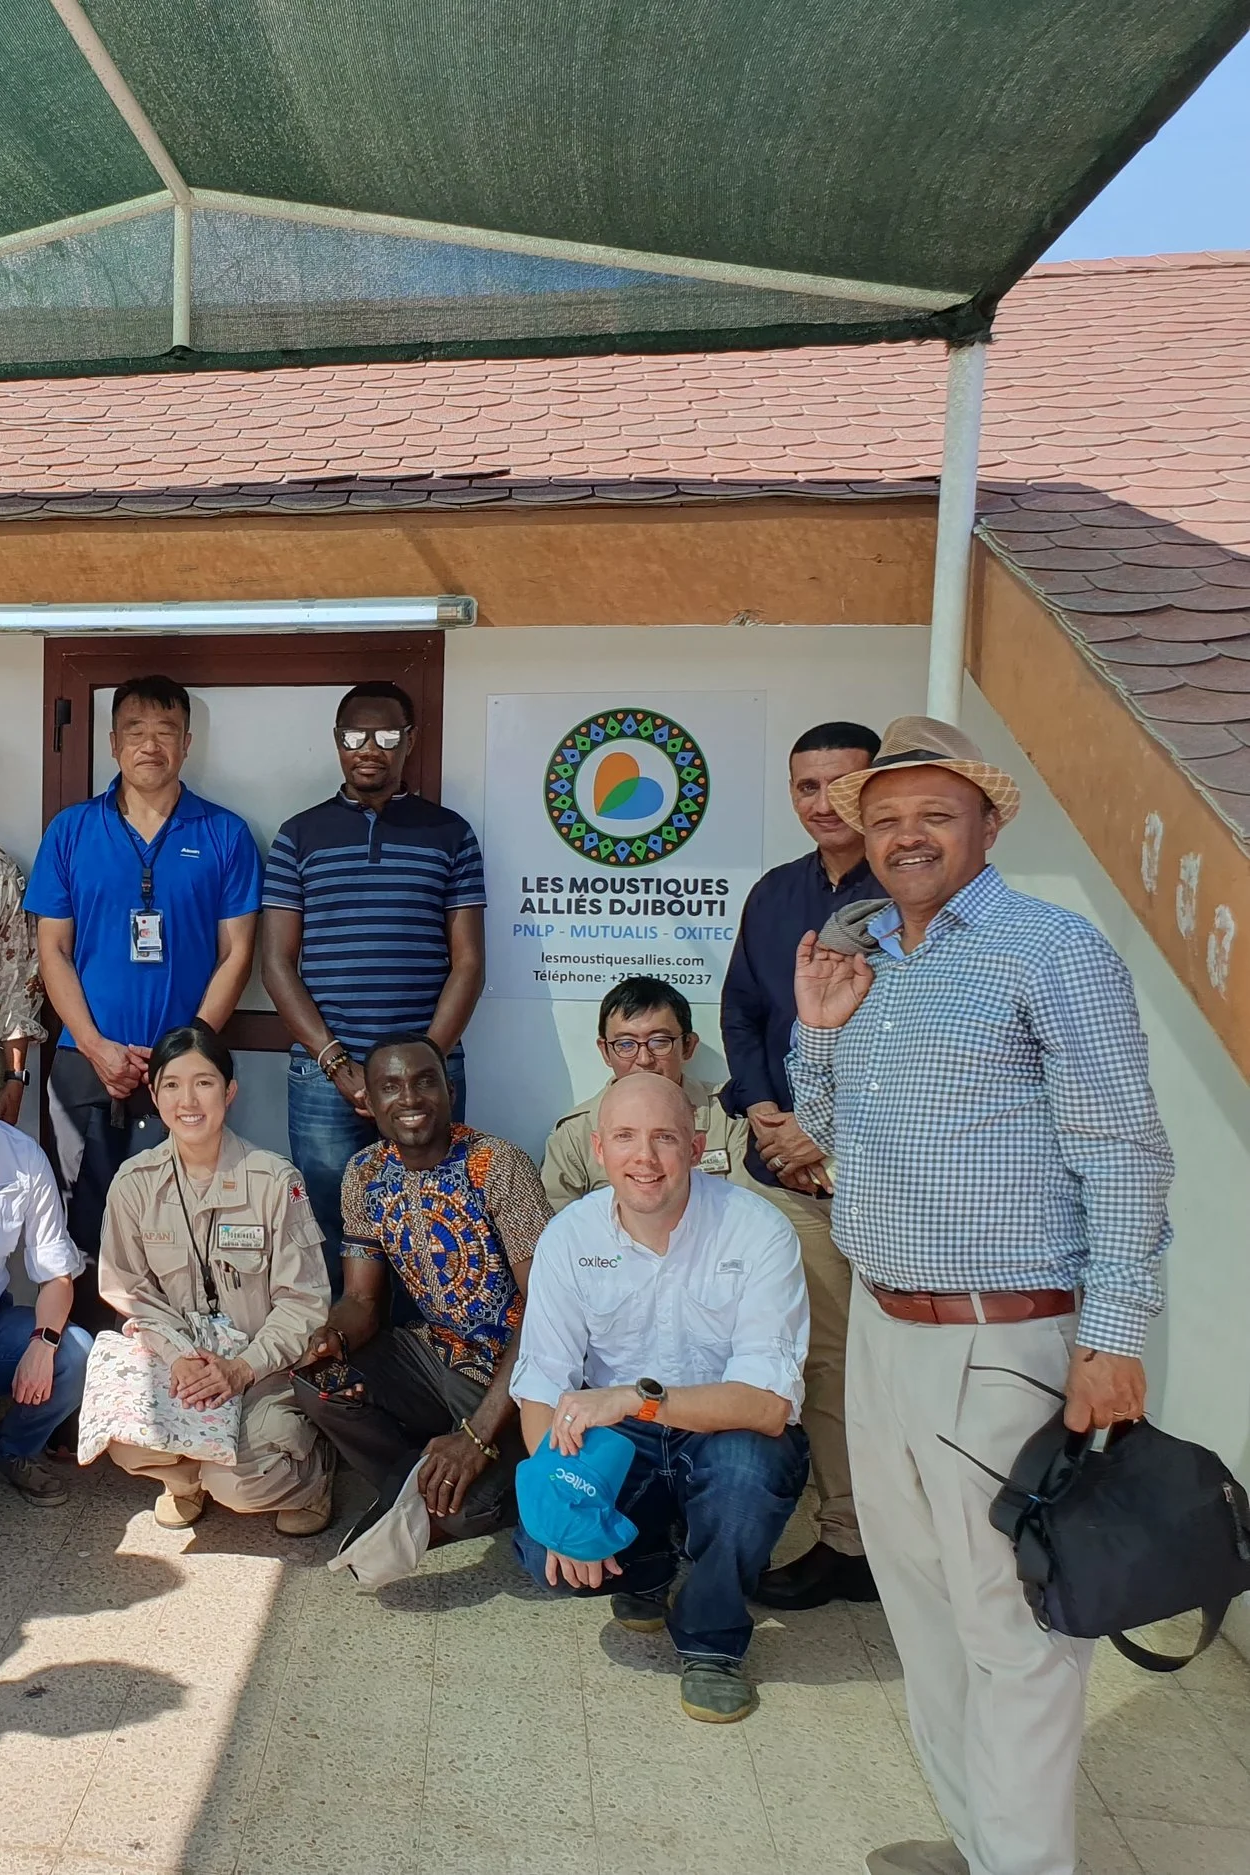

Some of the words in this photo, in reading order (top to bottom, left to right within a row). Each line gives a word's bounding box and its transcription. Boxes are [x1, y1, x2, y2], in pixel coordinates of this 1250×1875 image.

[521, 876, 565, 894] LES
[569, 877, 730, 899] MOUSTIQUES
[519, 894, 603, 915] ALLIÉS
[609, 898, 726, 917] DJIBOUTI
[512, 924, 555, 938] PNLP
[570, 925, 658, 940] MUTUALIS
[673, 926, 734, 941] OXITEC
[541, 952, 705, 968] lesmoustiquesallies.com
[533, 970, 607, 985] Téléphone:
[142, 1231, 171, 1241] APAN
[578, 1255, 618, 1269] oxitec
[555, 1467, 596, 1497] oxitec
